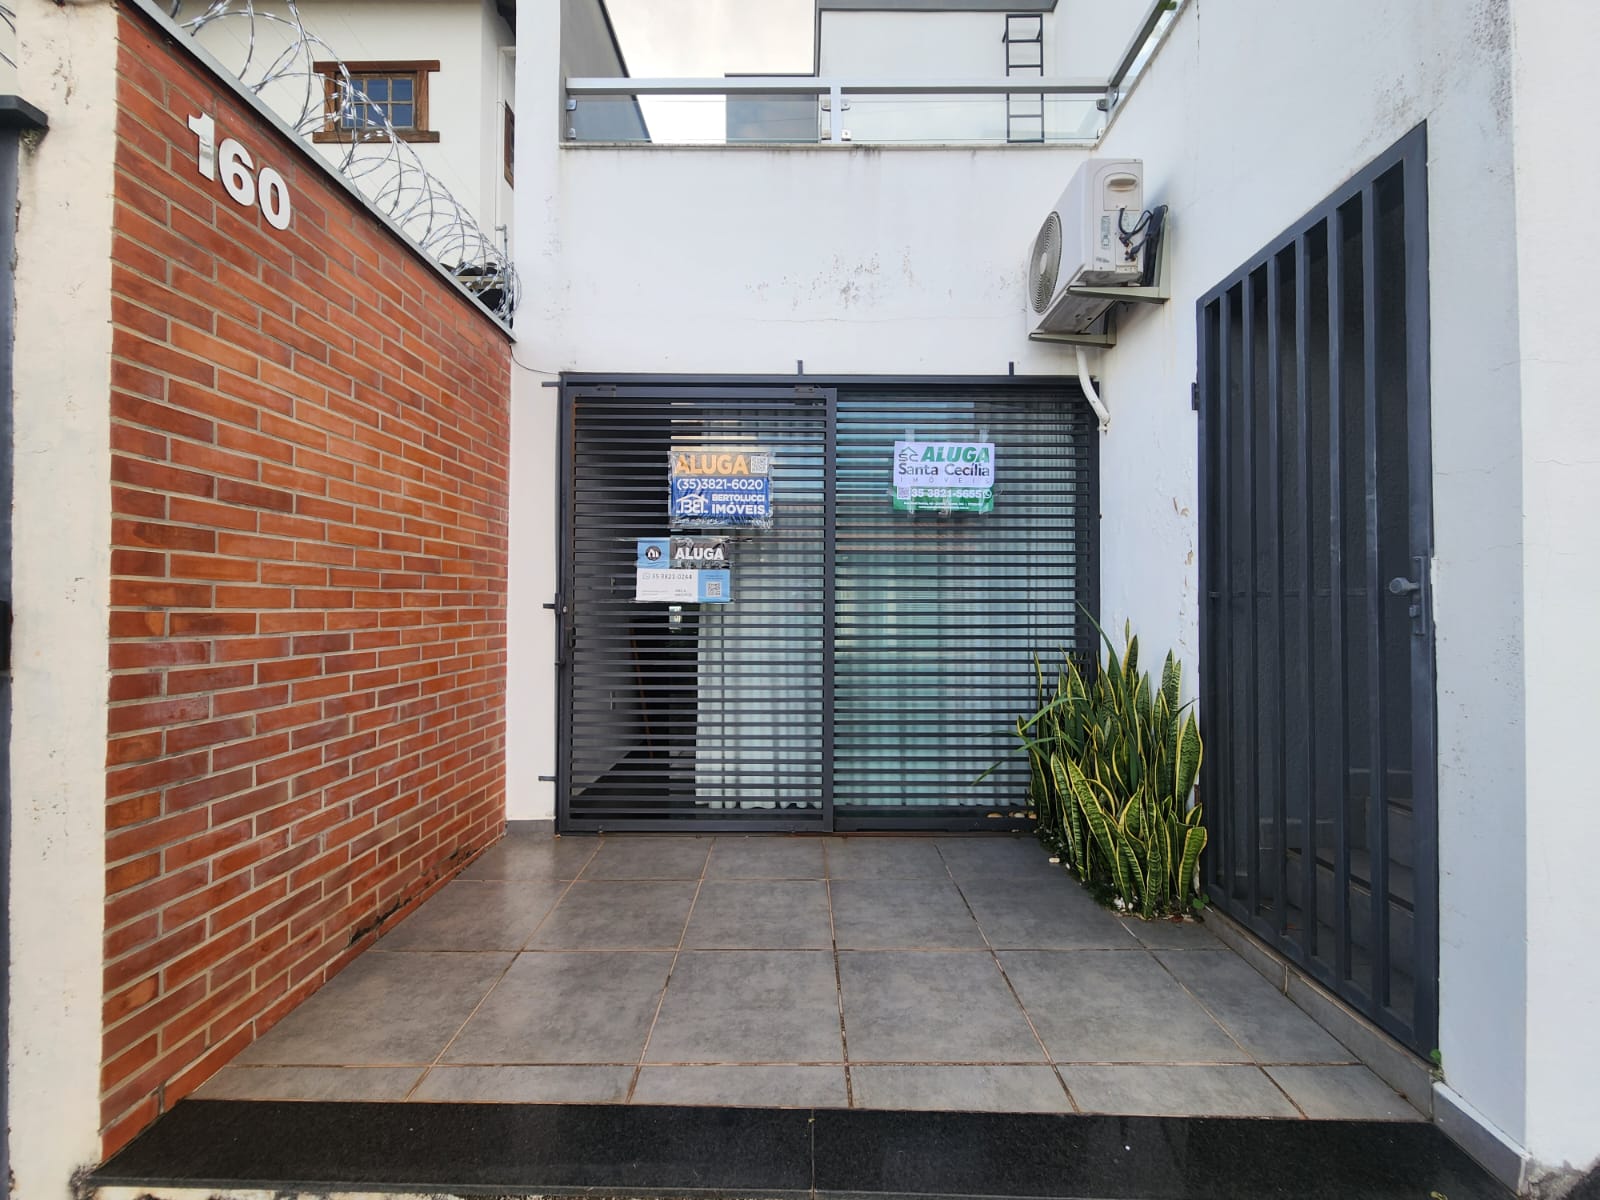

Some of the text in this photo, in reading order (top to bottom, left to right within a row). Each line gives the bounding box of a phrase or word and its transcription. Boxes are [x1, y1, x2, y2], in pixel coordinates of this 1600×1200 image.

[187, 111, 291, 231] 160
[920, 446, 989, 462] ALUGA
[675, 454, 749, 475] ALUGA
[898, 463, 989, 476] Santa Cecília
[676, 478, 763, 490] (35)3821-6020
[711, 493, 764, 502] BERTOLUCCI
[911, 489, 924, 497] 35
[711, 502, 764, 514] IMÓVEIS
[674, 547, 724, 560] ALUGA
